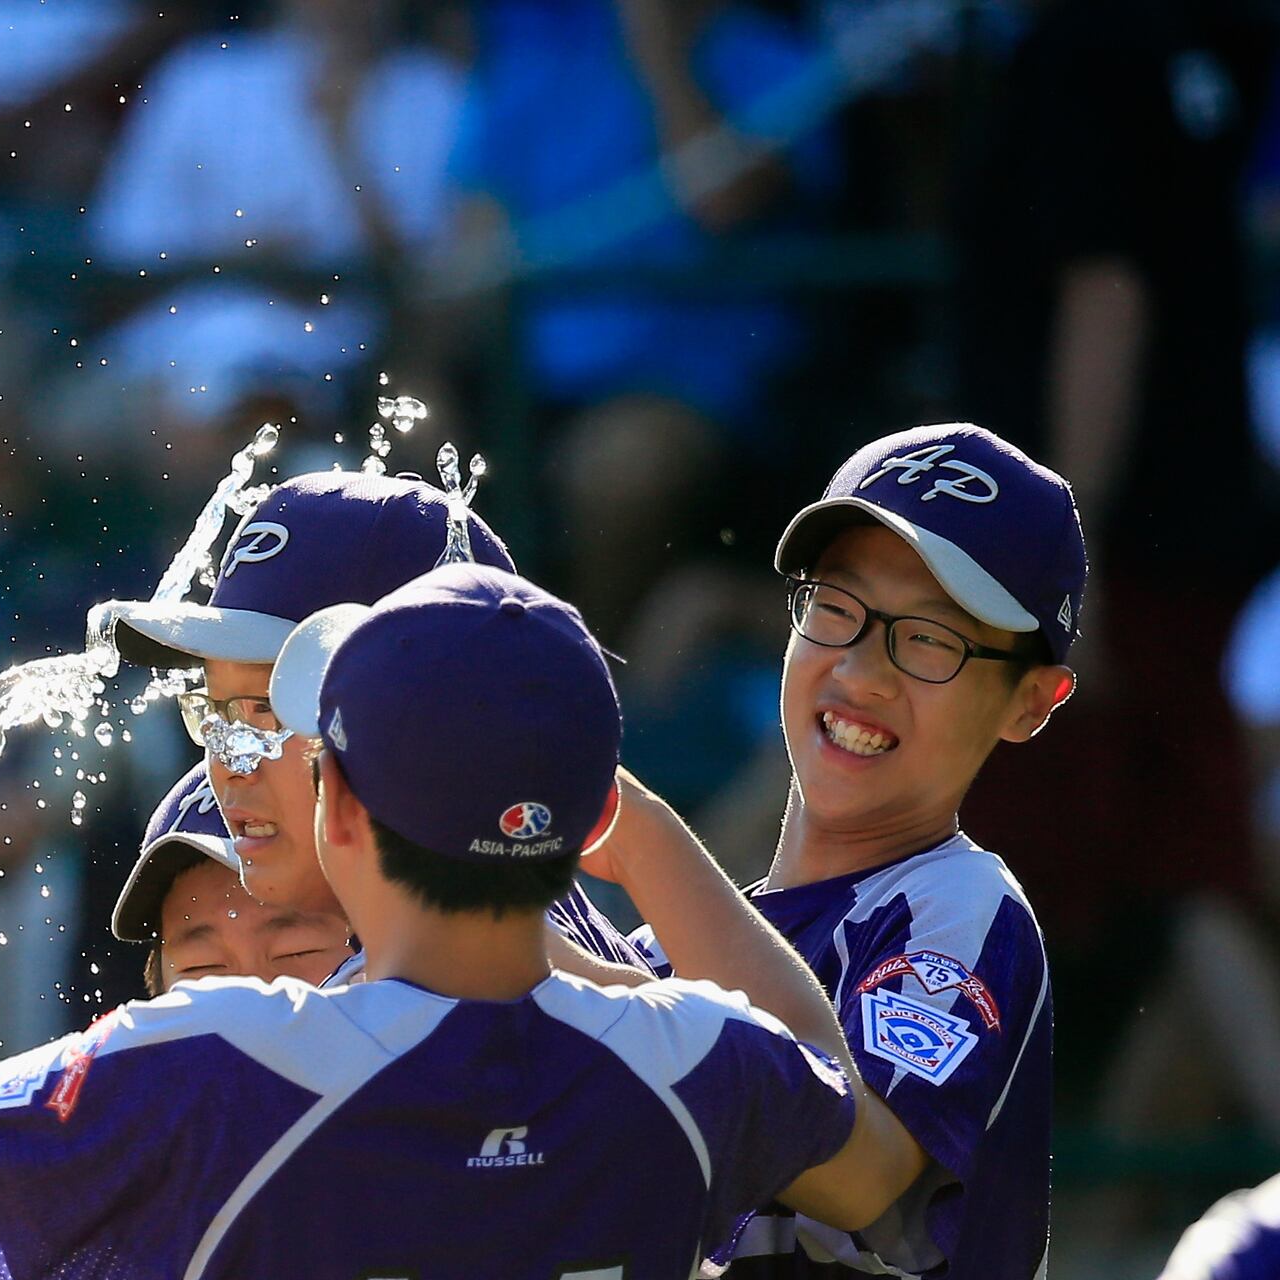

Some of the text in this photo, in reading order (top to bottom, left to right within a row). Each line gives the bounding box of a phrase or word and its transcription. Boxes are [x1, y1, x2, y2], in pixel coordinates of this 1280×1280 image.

[859, 444, 999, 503] AP
[468, 836, 563, 857] ASIA-PACIFIC
[924, 963, 950, 983] 75
[466, 1151, 545, 1168] RUSSELL
